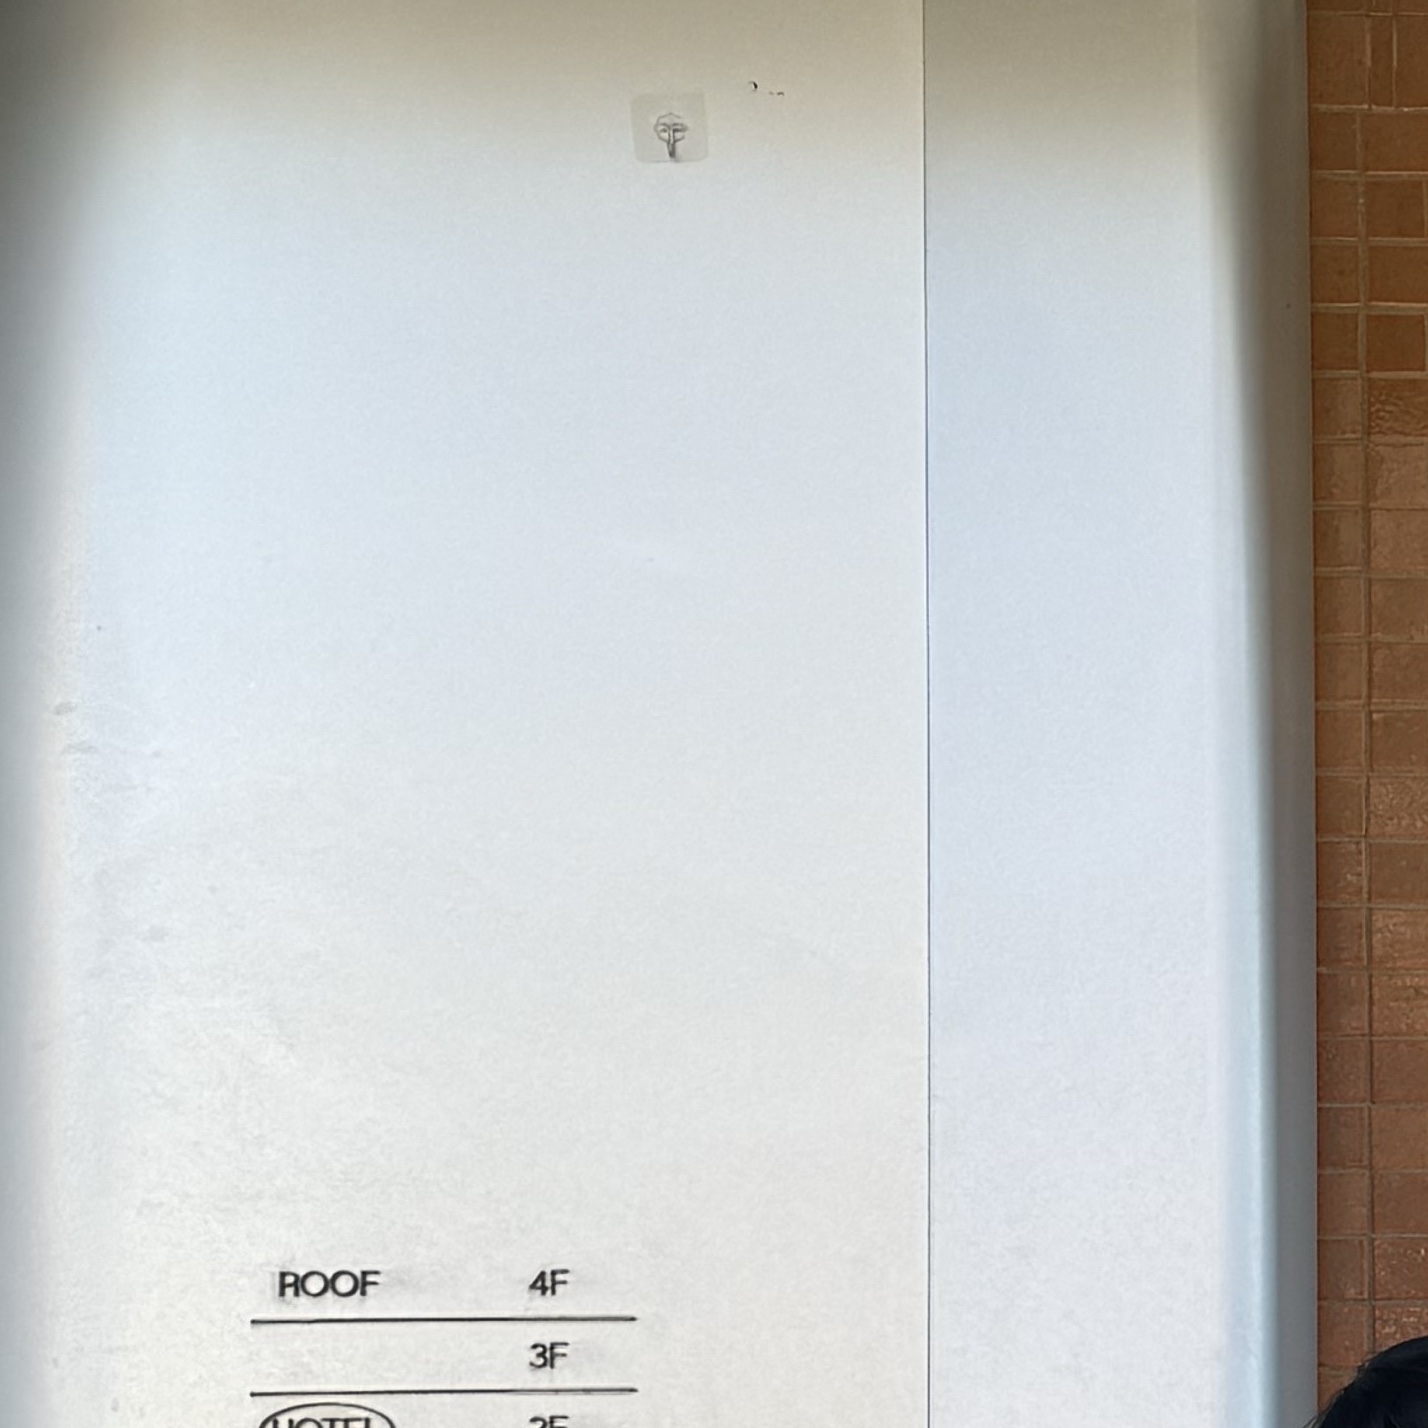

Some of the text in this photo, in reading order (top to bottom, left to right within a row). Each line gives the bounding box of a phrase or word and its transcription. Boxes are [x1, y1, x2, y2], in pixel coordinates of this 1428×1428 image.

[278, 1268, 570, 1299] ROOF 4F
[528, 1341, 570, 1370] 3F
